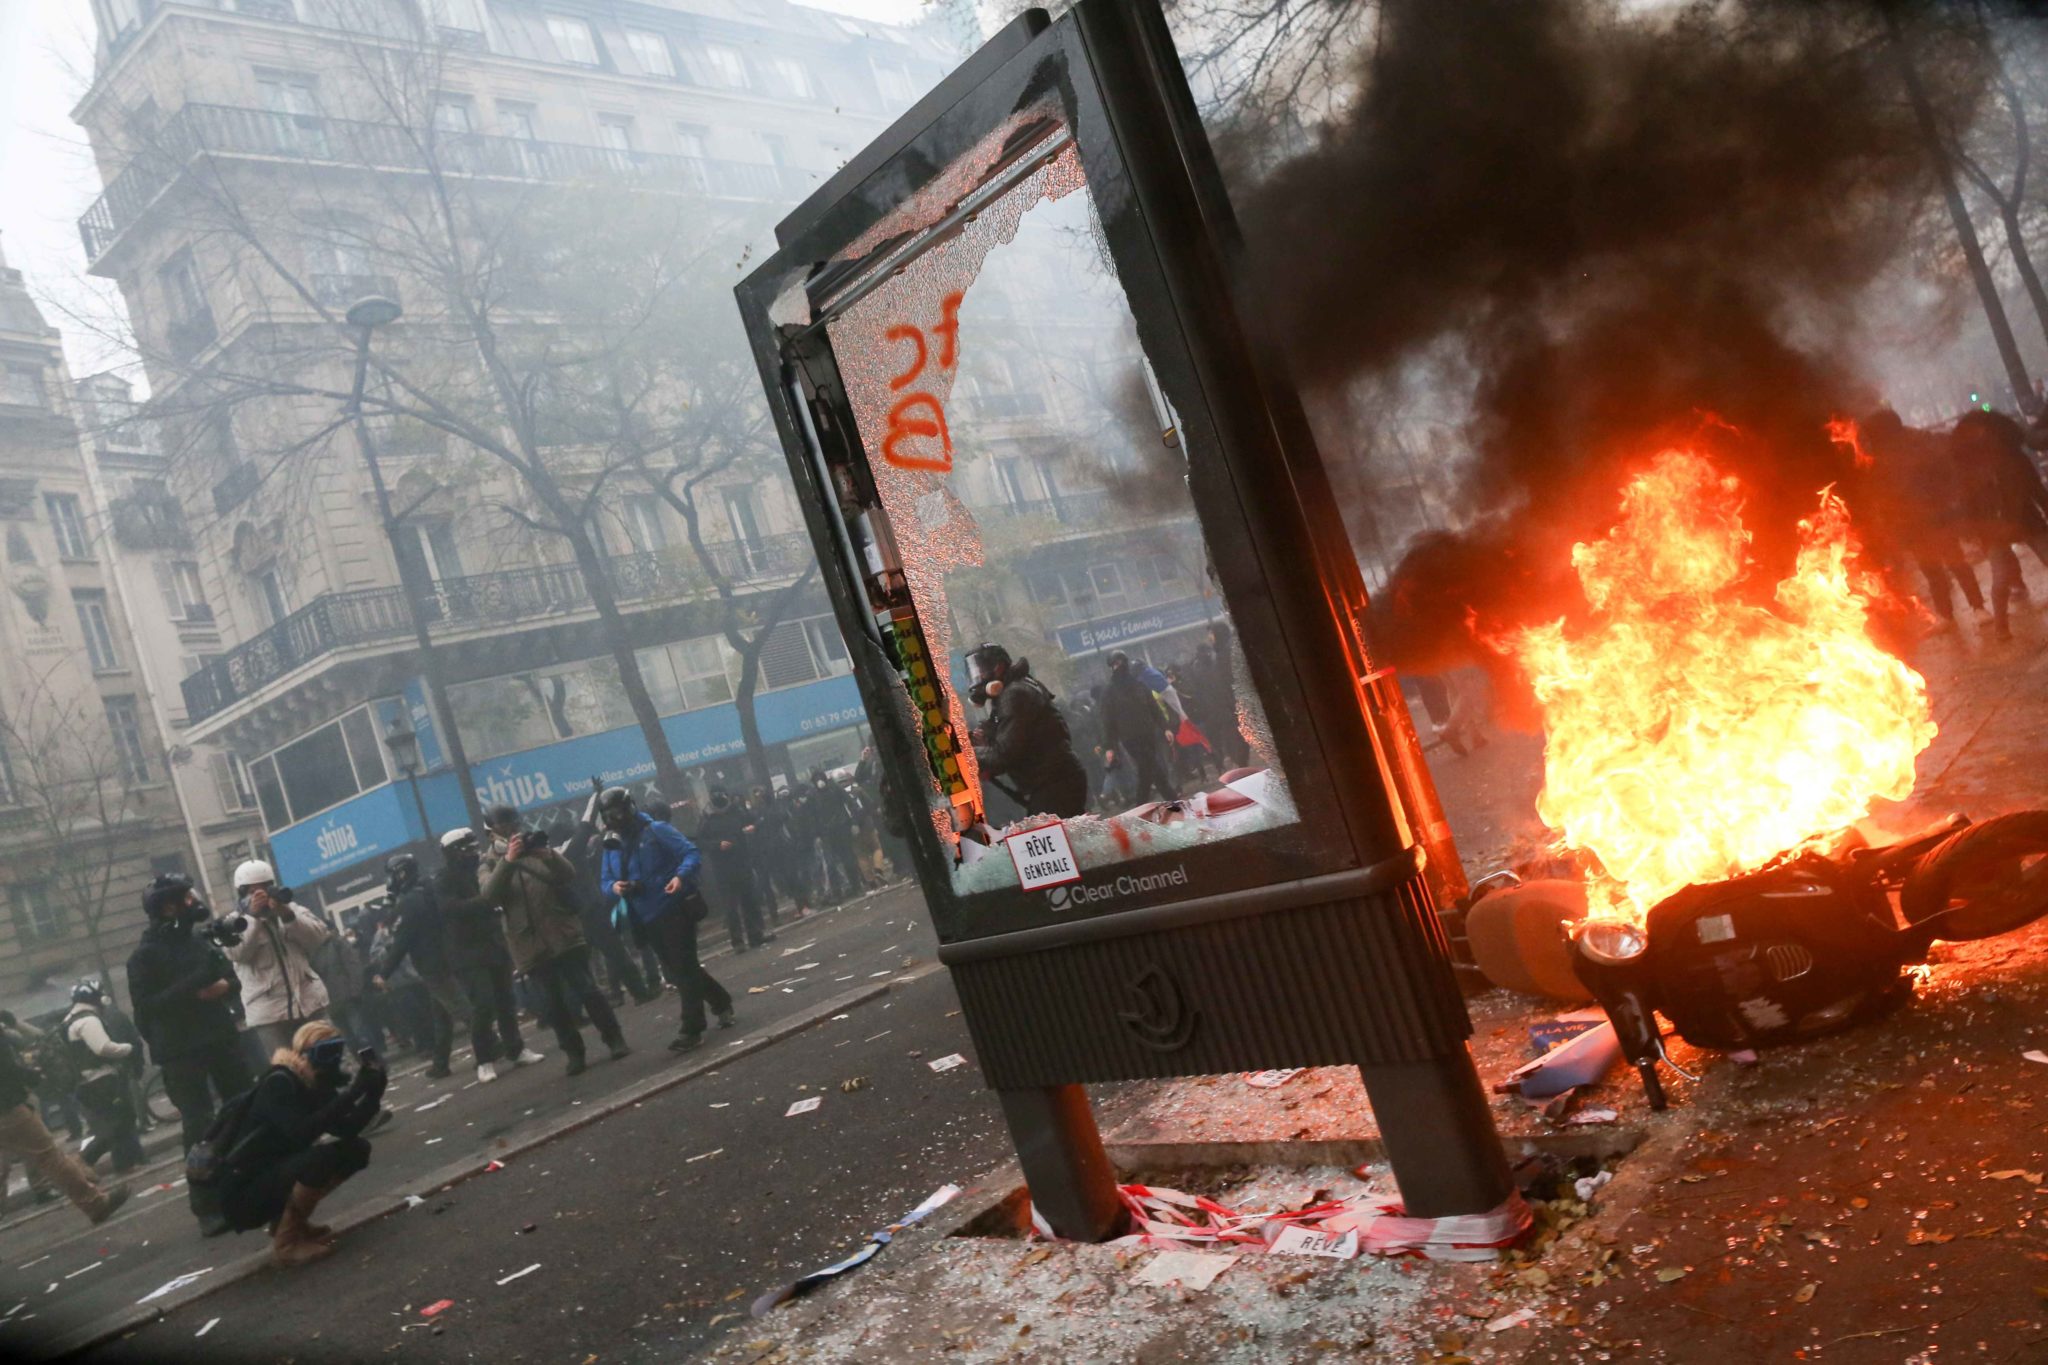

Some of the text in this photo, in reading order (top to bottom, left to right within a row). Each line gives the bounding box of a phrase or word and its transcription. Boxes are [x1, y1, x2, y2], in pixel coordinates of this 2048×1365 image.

[801, 719, 812, 730] 01
[842, 708, 857, 720] 00
[702, 743, 727, 756] chez
[475, 765, 554, 816] shiva
[317, 822, 357, 859] shiva
[1025, 835, 1056, 857] RÊVE
[1024, 857, 1070, 880] GÉNÉRALE
[1071, 864, 1188, 904] Clear Channel
